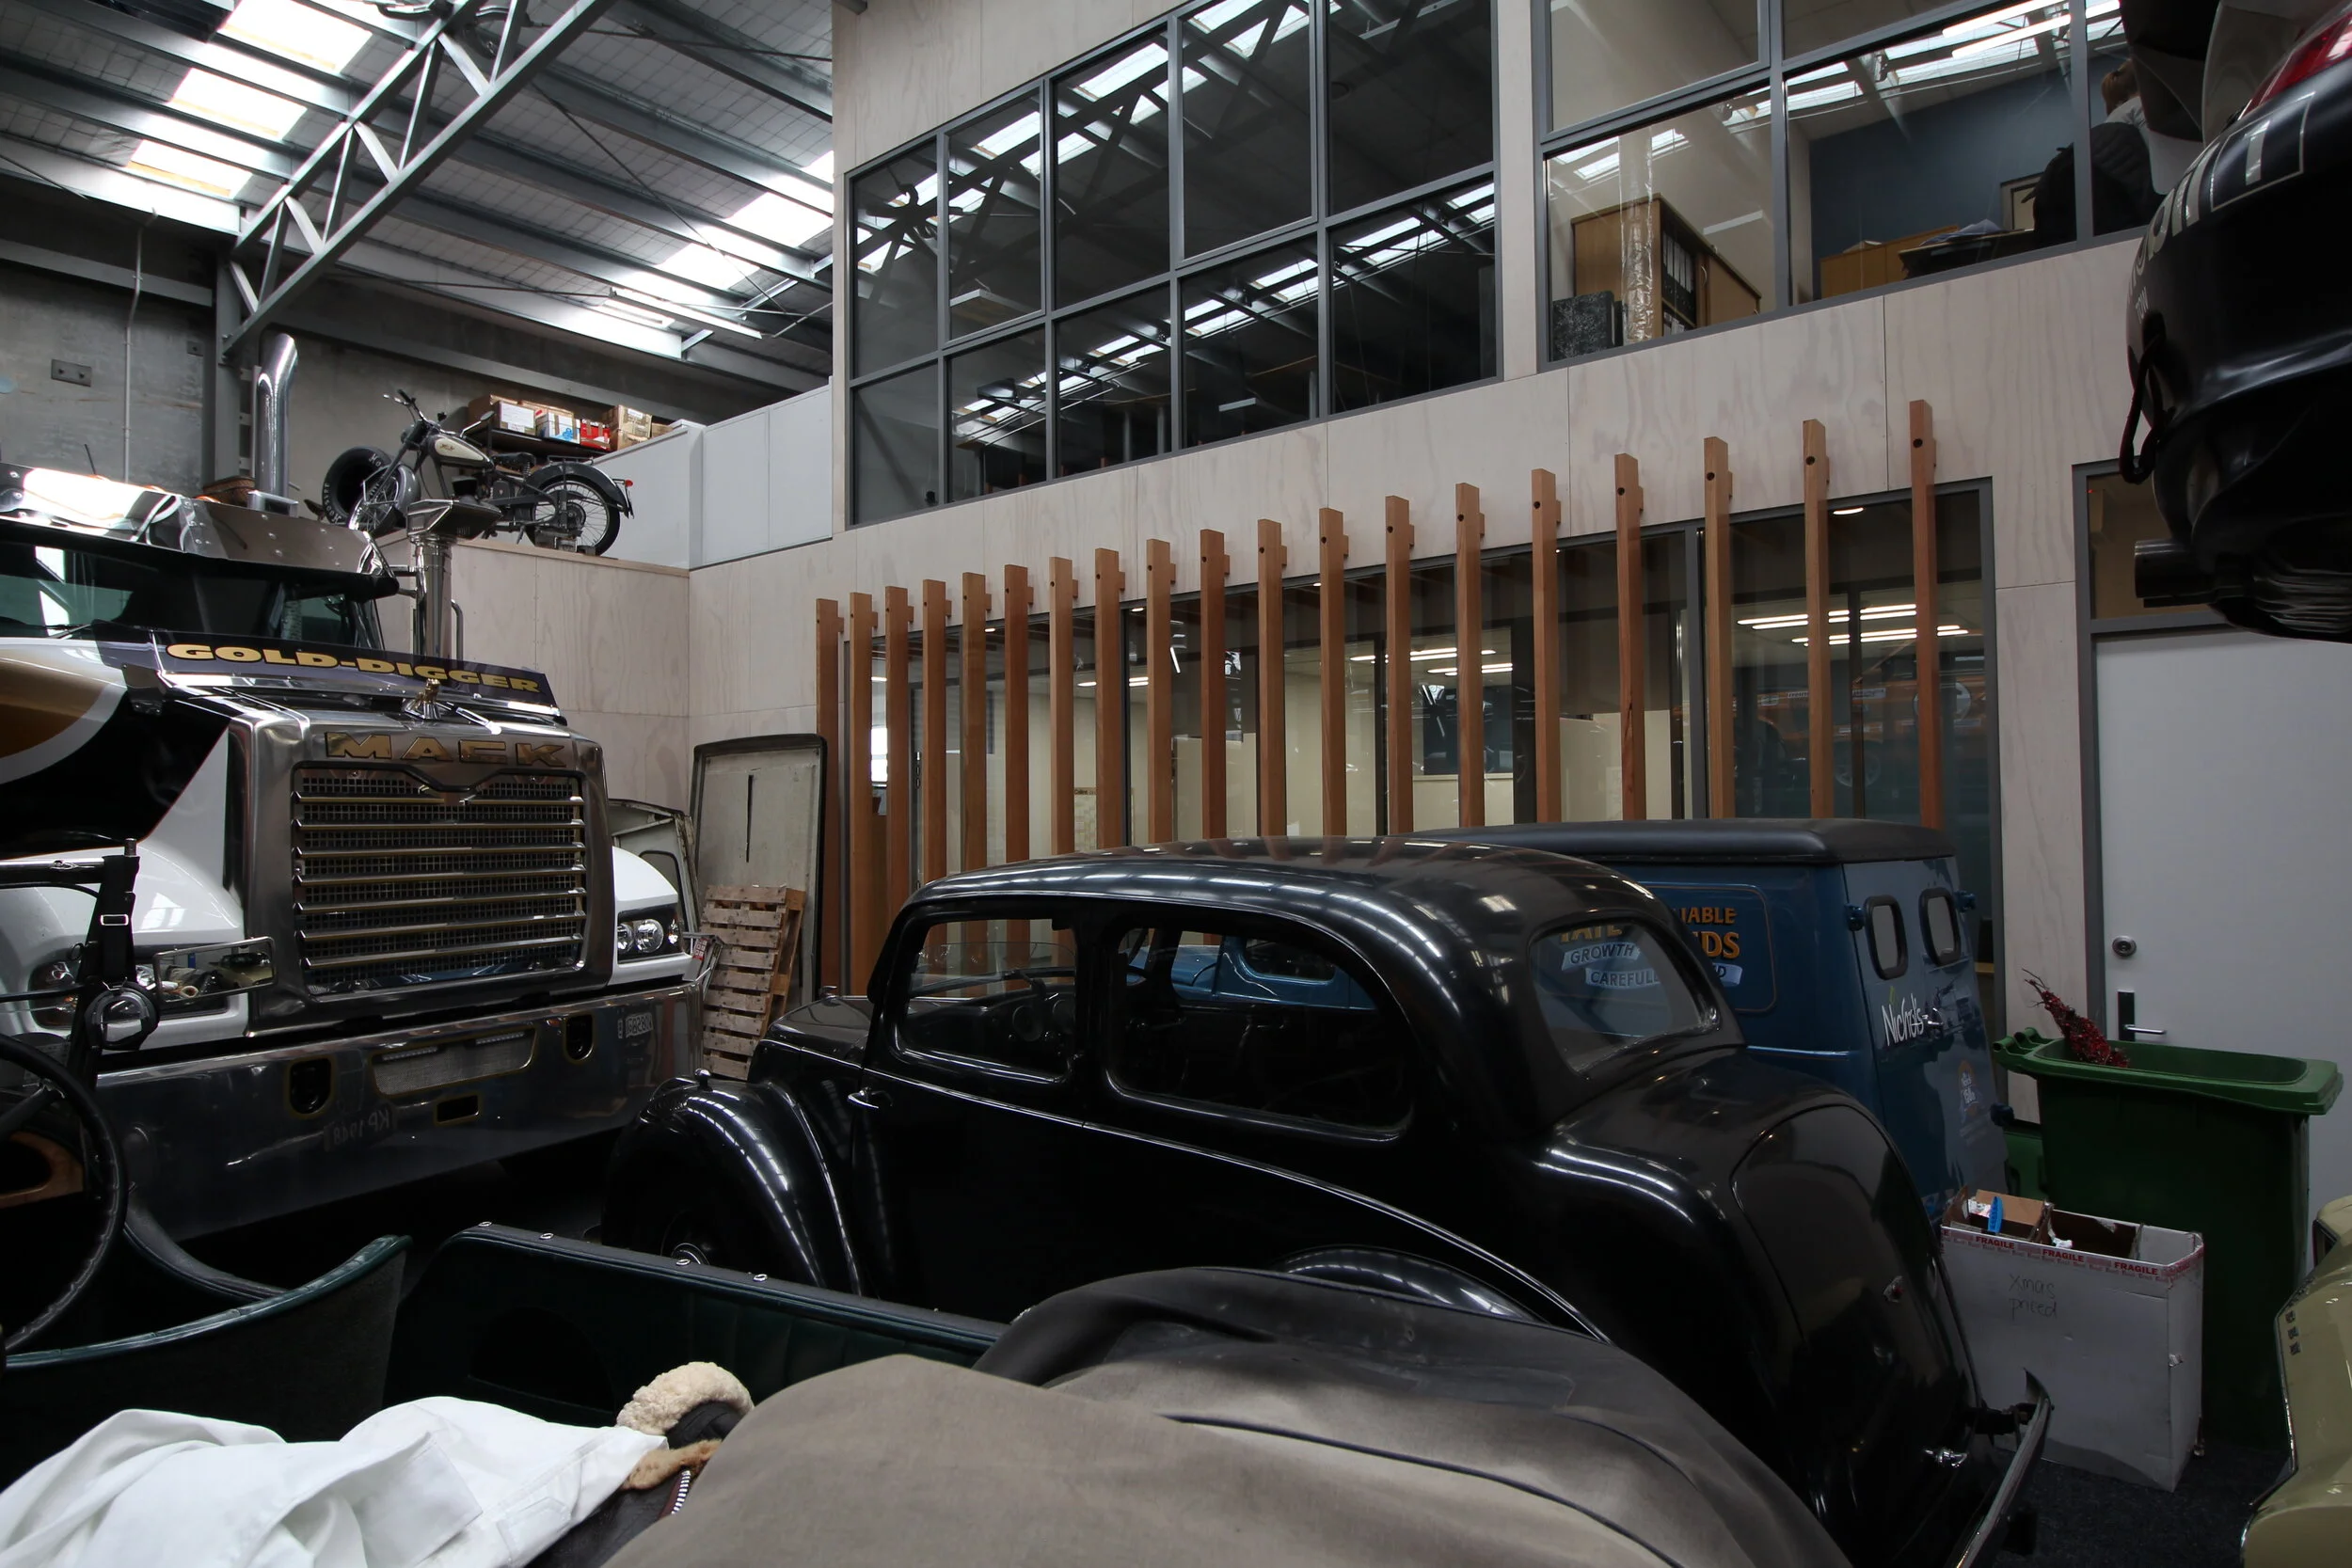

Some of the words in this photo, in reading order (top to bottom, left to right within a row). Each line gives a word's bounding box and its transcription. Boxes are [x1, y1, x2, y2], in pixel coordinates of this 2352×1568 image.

[2135, 286, 2150, 324] TOW
[165, 641, 543, 694] GOLD-DIGGER
[325, 731, 567, 768] MACK
[1679, 906, 1739, 926] IABLE
[1570, 942, 1634, 964] GROWTH
[1976, 1236, 2015, 1250] FRAGILE
[2042, 1248, 2085, 1263] FRAGILE
[2114, 1261, 2158, 1275] FRAGILE
